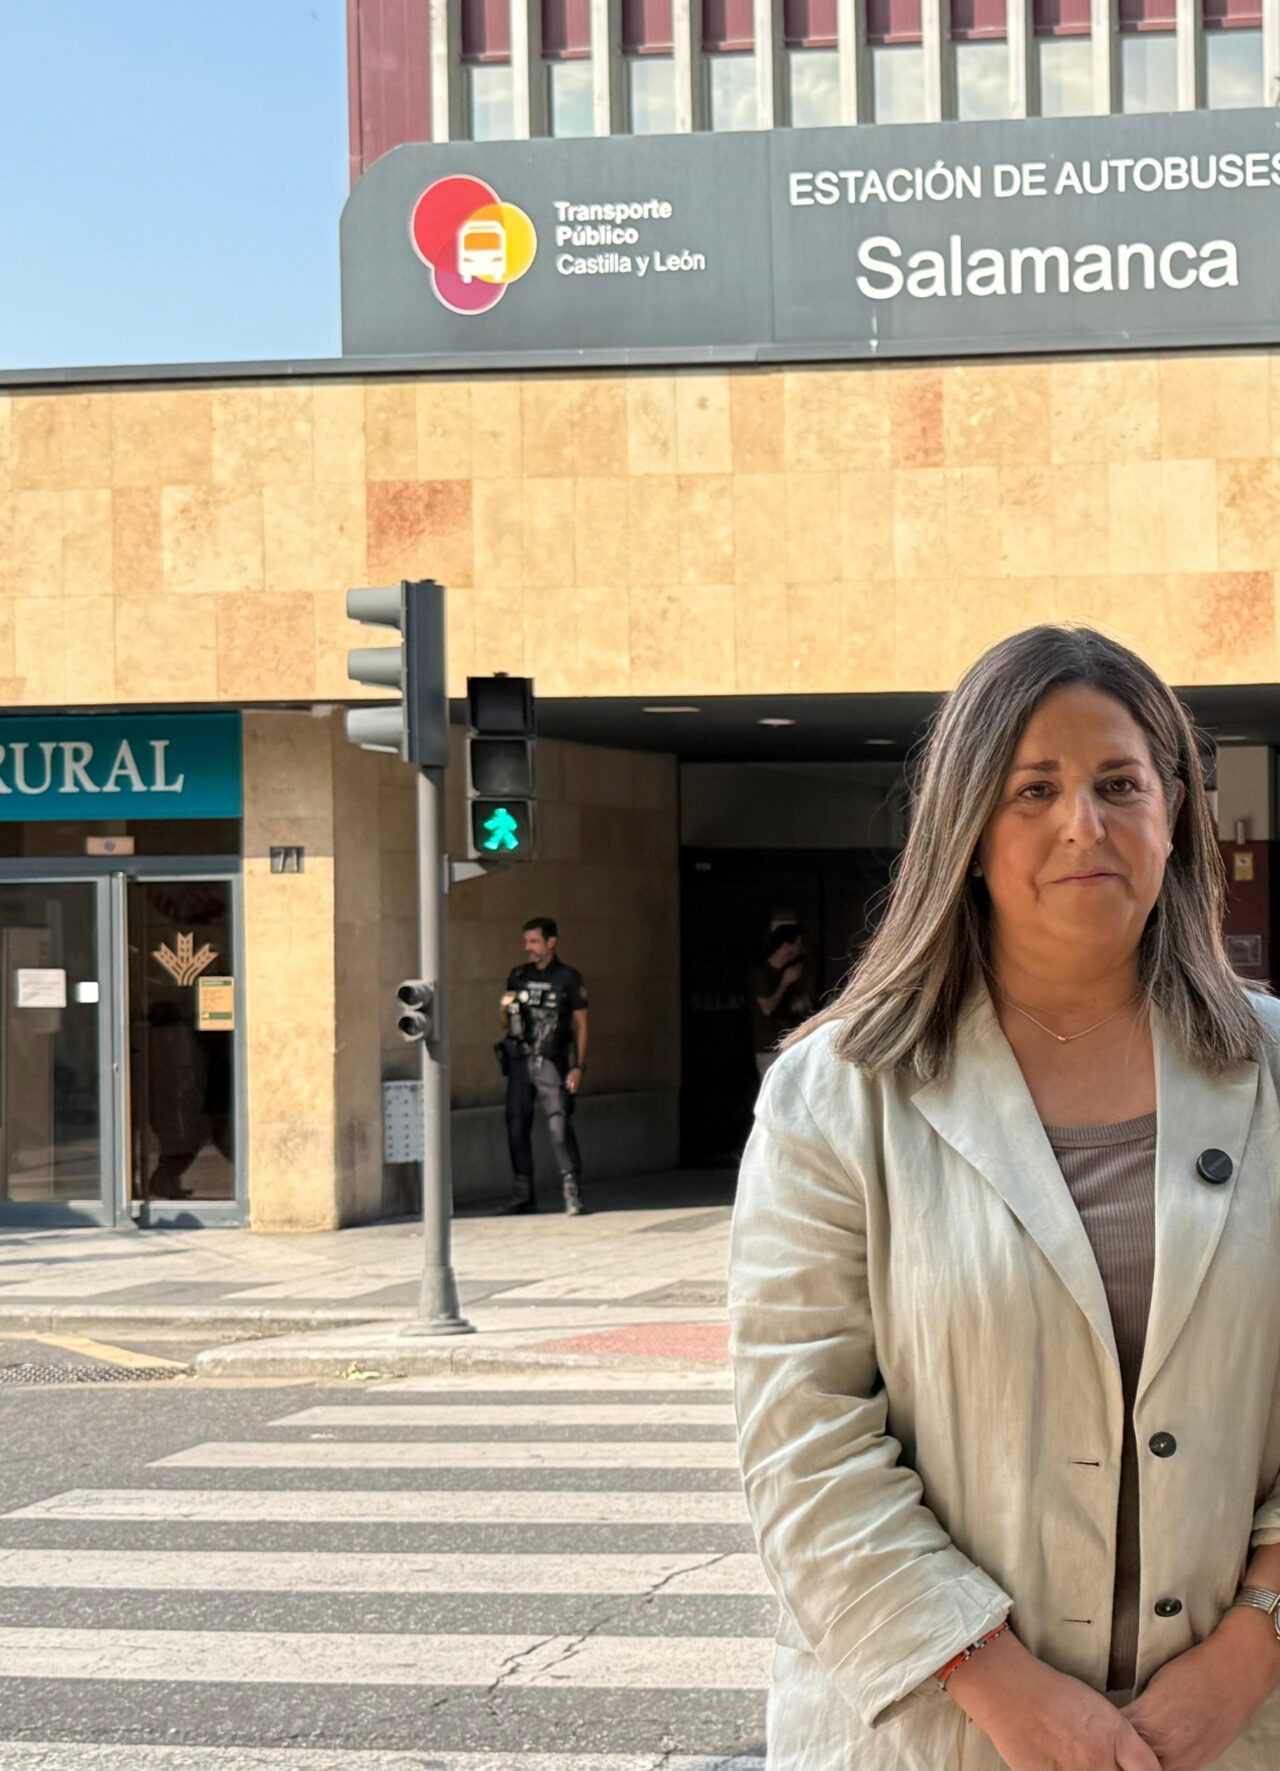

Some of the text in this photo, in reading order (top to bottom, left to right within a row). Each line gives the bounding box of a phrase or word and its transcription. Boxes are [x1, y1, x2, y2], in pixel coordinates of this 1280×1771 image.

[789, 160, 982, 206] ESTACIÓN
[993, 162, 1048, 197] DE
[553, 199, 673, 224] Transporte
[555, 225, 640, 247] Público
[556, 249, 706, 277] Castilla y León
[856, 234, 1240, 299] Salamanca
